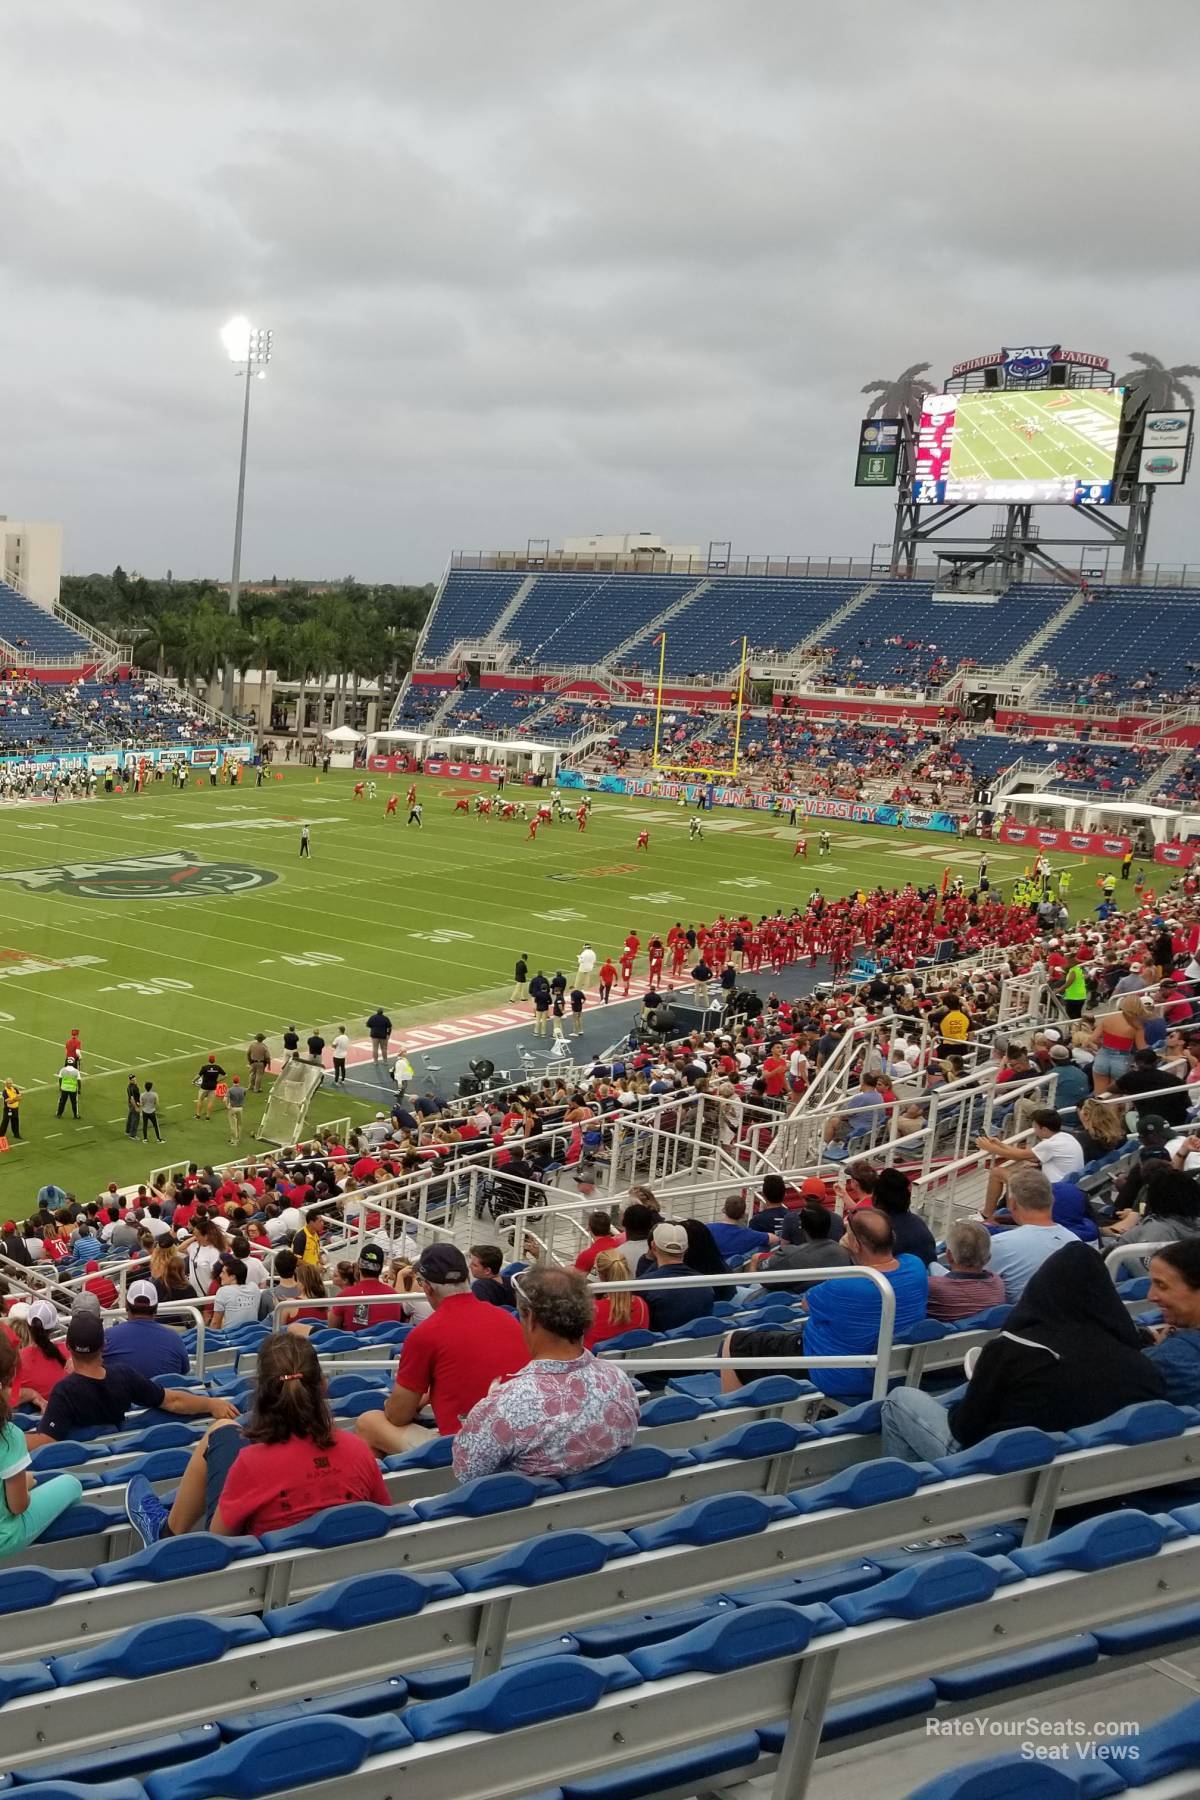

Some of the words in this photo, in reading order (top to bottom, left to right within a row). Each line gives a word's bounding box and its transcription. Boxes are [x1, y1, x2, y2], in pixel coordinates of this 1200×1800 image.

[953, 353, 1002, 374] SCHMIDT
[1060, 351, 1106, 367] FAMILY
[1153, 420, 1180, 430] Ford
[691, 785, 770, 808] ALANIC
[774, 798, 878, 821] NVERSITY
[978, 791, 992, 803] 17
[407, 928, 475, 944] 50
[282, 950, 346, 968] 40
[116, 977, 195, 995] 30
[54, 1239, 69, 1256] 10
